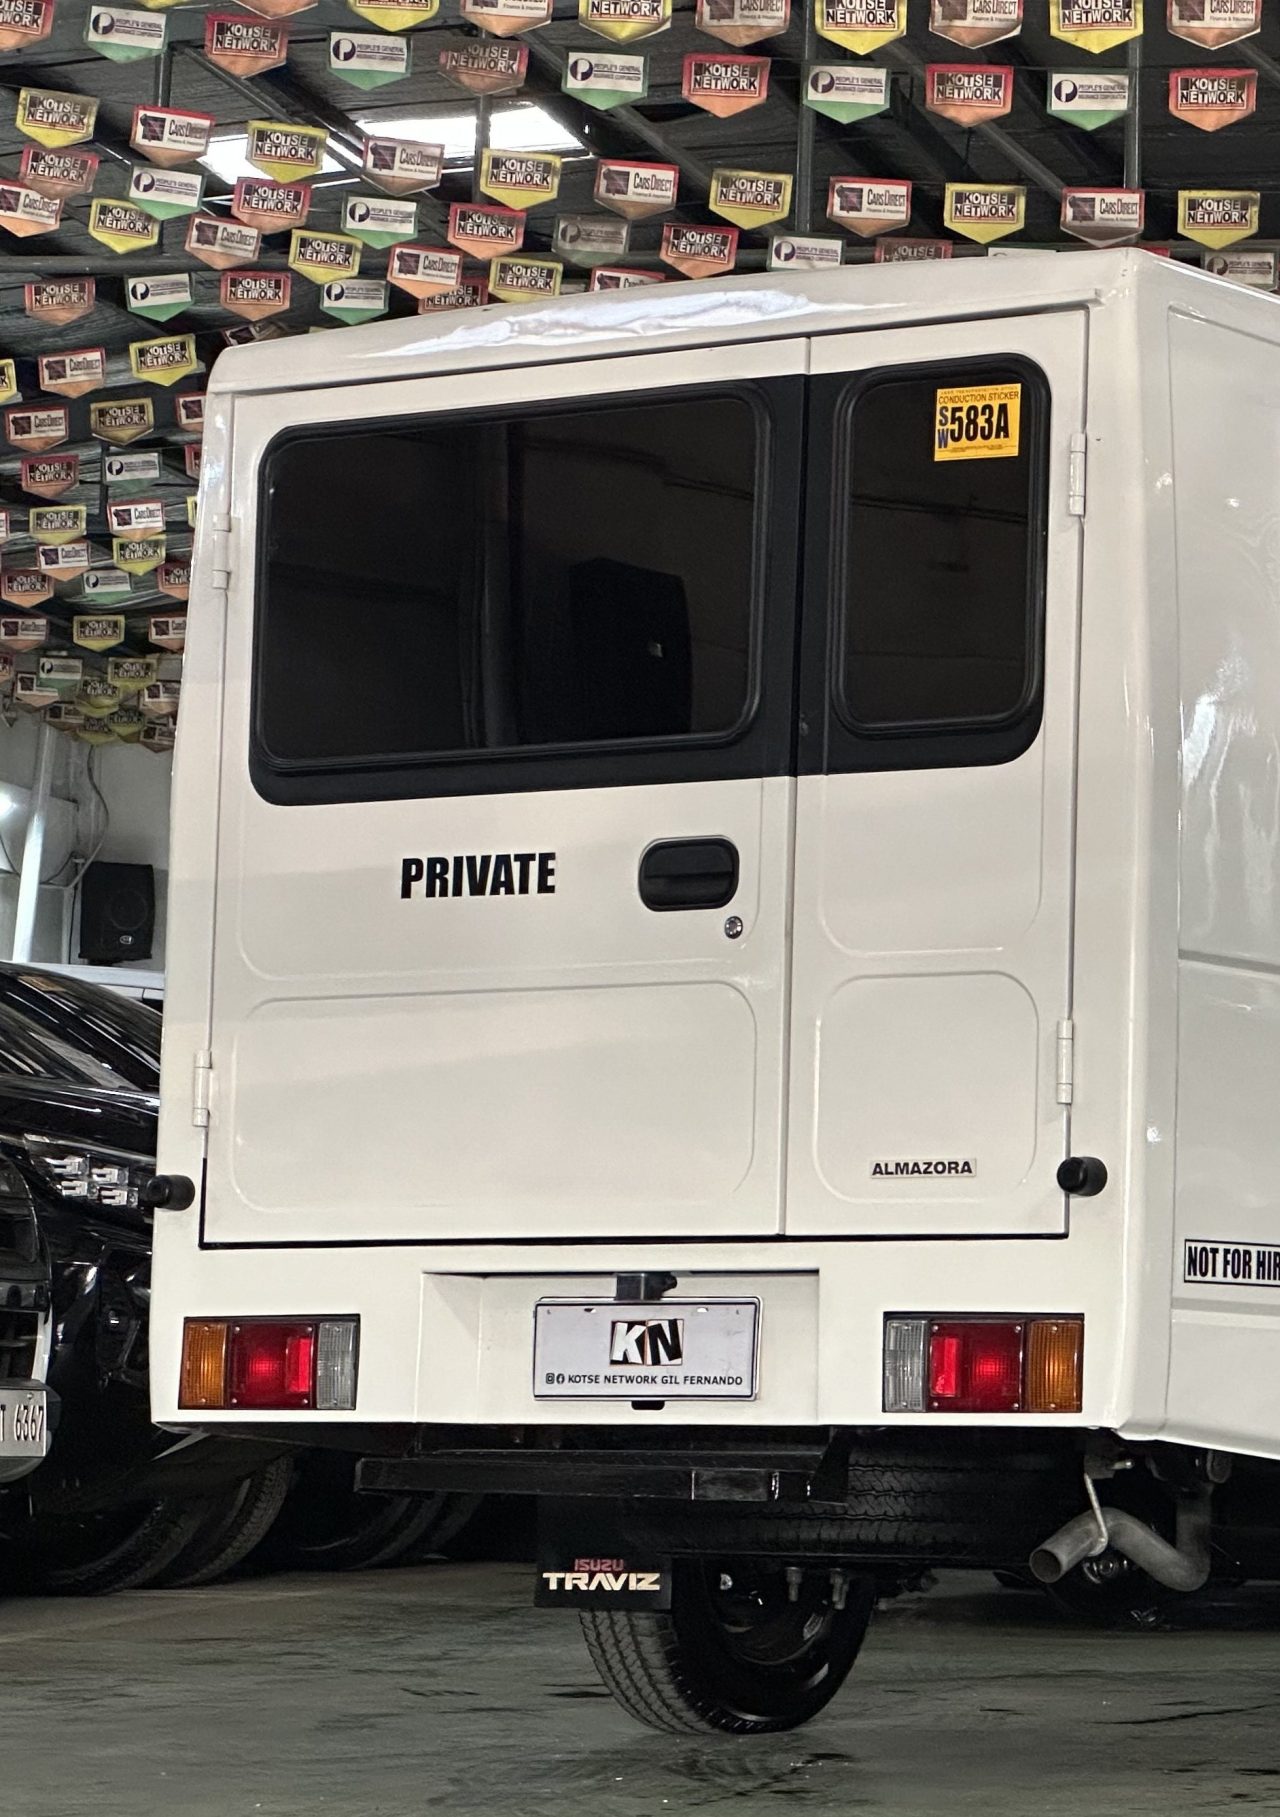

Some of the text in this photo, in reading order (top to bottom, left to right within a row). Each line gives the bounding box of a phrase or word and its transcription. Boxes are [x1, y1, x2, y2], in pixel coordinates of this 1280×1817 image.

[591, 4, 660, 17] NETWORK
[827, 9, 895, 24] NETWORK
[1062, 10, 1131, 23] NETWORK
[225, 22, 271, 37] KOTSE
[215, 36, 278, 51] NETWORK
[703, 63, 749, 77] KOTSE
[693, 76, 757, 90] NETWORK
[946, 73, 992, 87] KOTSE
[1191, 78, 1236, 91] KOTSE
[937, 86, 1001, 100] NETWORK
[1180, 90, 1244, 103] NETWORK
[27, 110, 84, 126] NETWORK
[264, 131, 308, 146] KOTSE
[256, 143, 314, 159] NETWORK
[39, 152, 80, 169] KOTSE
[501, 157, 544, 172] KOTSE
[30, 163, 84, 182] NETWORK
[490, 170, 550, 186] NETWORK
[730, 178, 773, 191] KOTSE
[253, 185, 293, 200] KOTSE
[720, 189, 780, 204] NETWORK
[963, 193, 1007, 205] KOTSE
[244, 196, 299, 213] NETWORK
[955, 205, 1015, 217] NETWORK
[1197, 200, 1240, 211] KOTSE
[1188, 211, 1248, 223] NETWORK
[98, 217, 150, 233] NETWORK
[458, 224, 514, 238] NETWORK
[682, 230, 721, 244] KOTSE
[307, 238, 346, 252] KOTSE
[671, 241, 726, 257] NETWORK
[299, 249, 350, 265] NETWORK
[508, 263, 546, 277] KOTSE
[237, 278, 274, 289] KOTSE
[229, 288, 281, 299] NETWORK
[938, 391, 1019, 405] CONDUCTION STICKER
[949, 402, 1010, 443] 583A
[401, 852, 556, 899] PRIVATE
[872, 1160, 973, 1176] ALMAZORA
[1187, 1246, 1217, 1278] NOT
[1223, 1248, 1252, 1280] FOR
[568, 1374, 743, 1386] KOTSE NETWORK GIL FERNANDO
[14, 1404, 44, 1442] 6367
[574, 1559, 624, 1571] ISUZU
[542, 1573, 661, 1590] TRAVIZ
